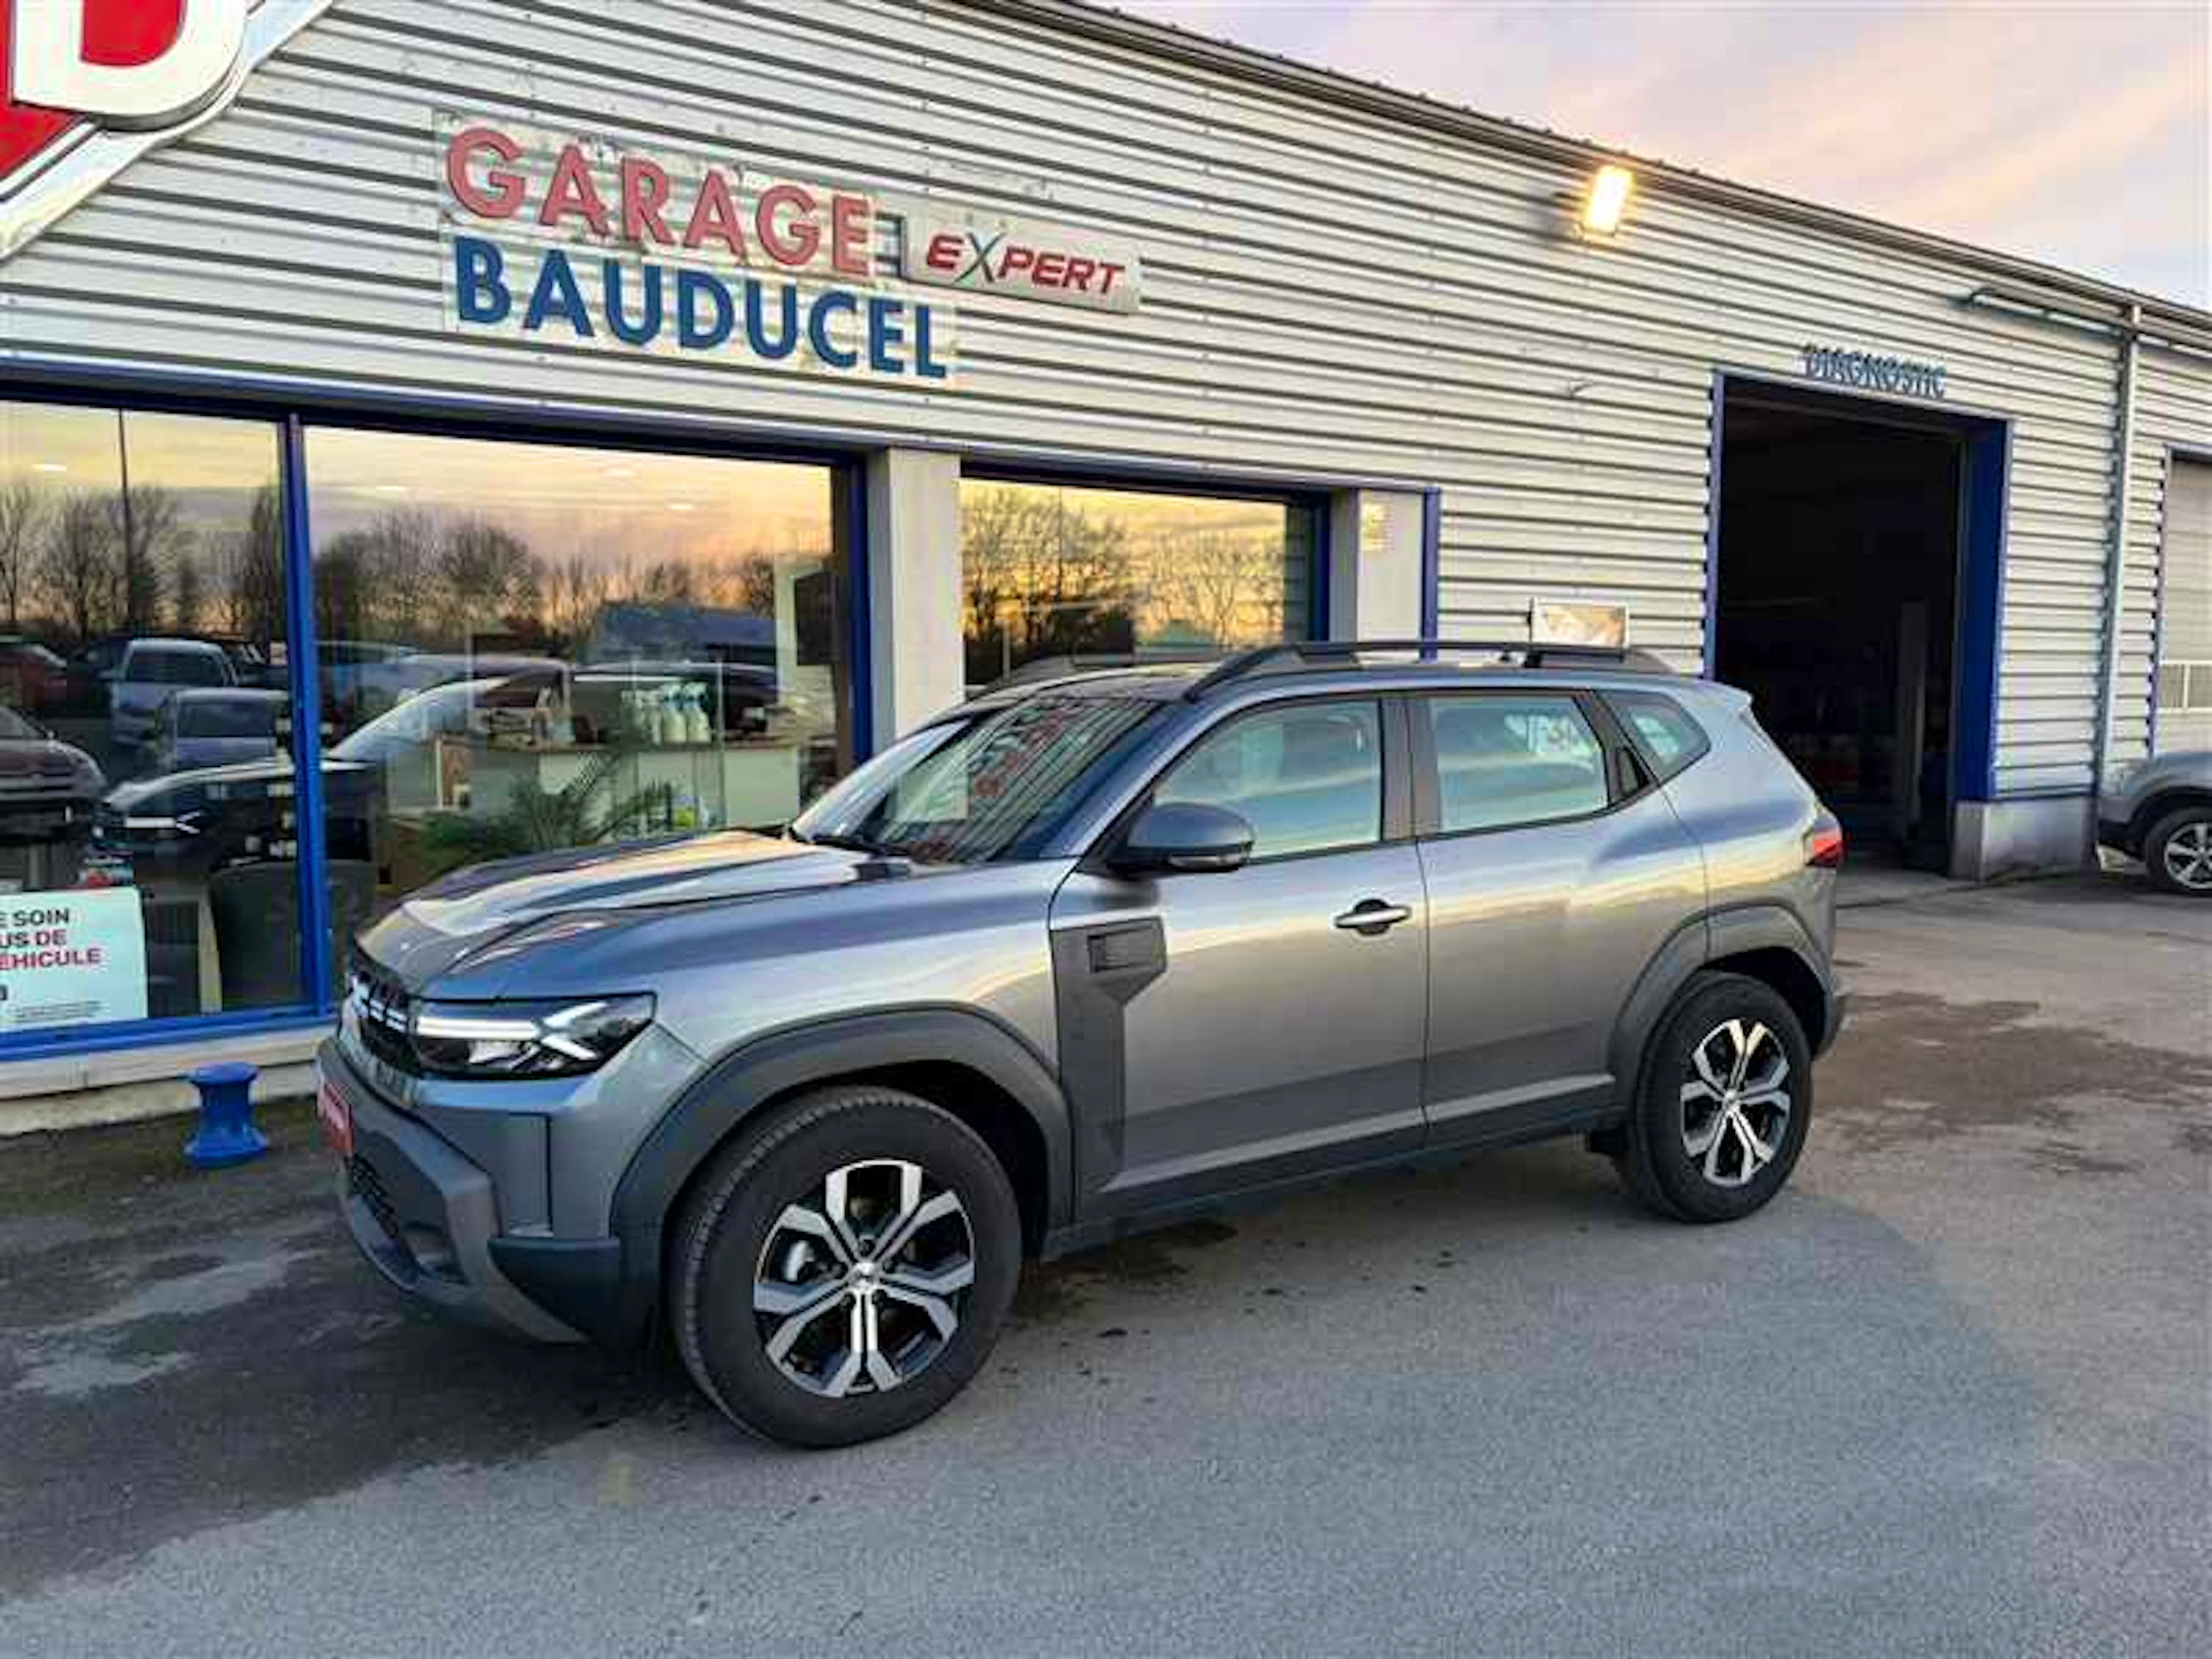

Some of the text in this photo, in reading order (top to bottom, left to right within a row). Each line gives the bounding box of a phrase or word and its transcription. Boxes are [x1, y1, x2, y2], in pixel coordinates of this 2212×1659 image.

[446, 127, 870, 278] GARAGE
[926, 232, 1125, 293] EXPERT
[454, 235, 948, 379] BAUDUCEL
[1802, 346, 1947, 399] DIAGNOSTIC
[13, 908, 69, 926] SOIN
[36, 929, 66, 945] DE
